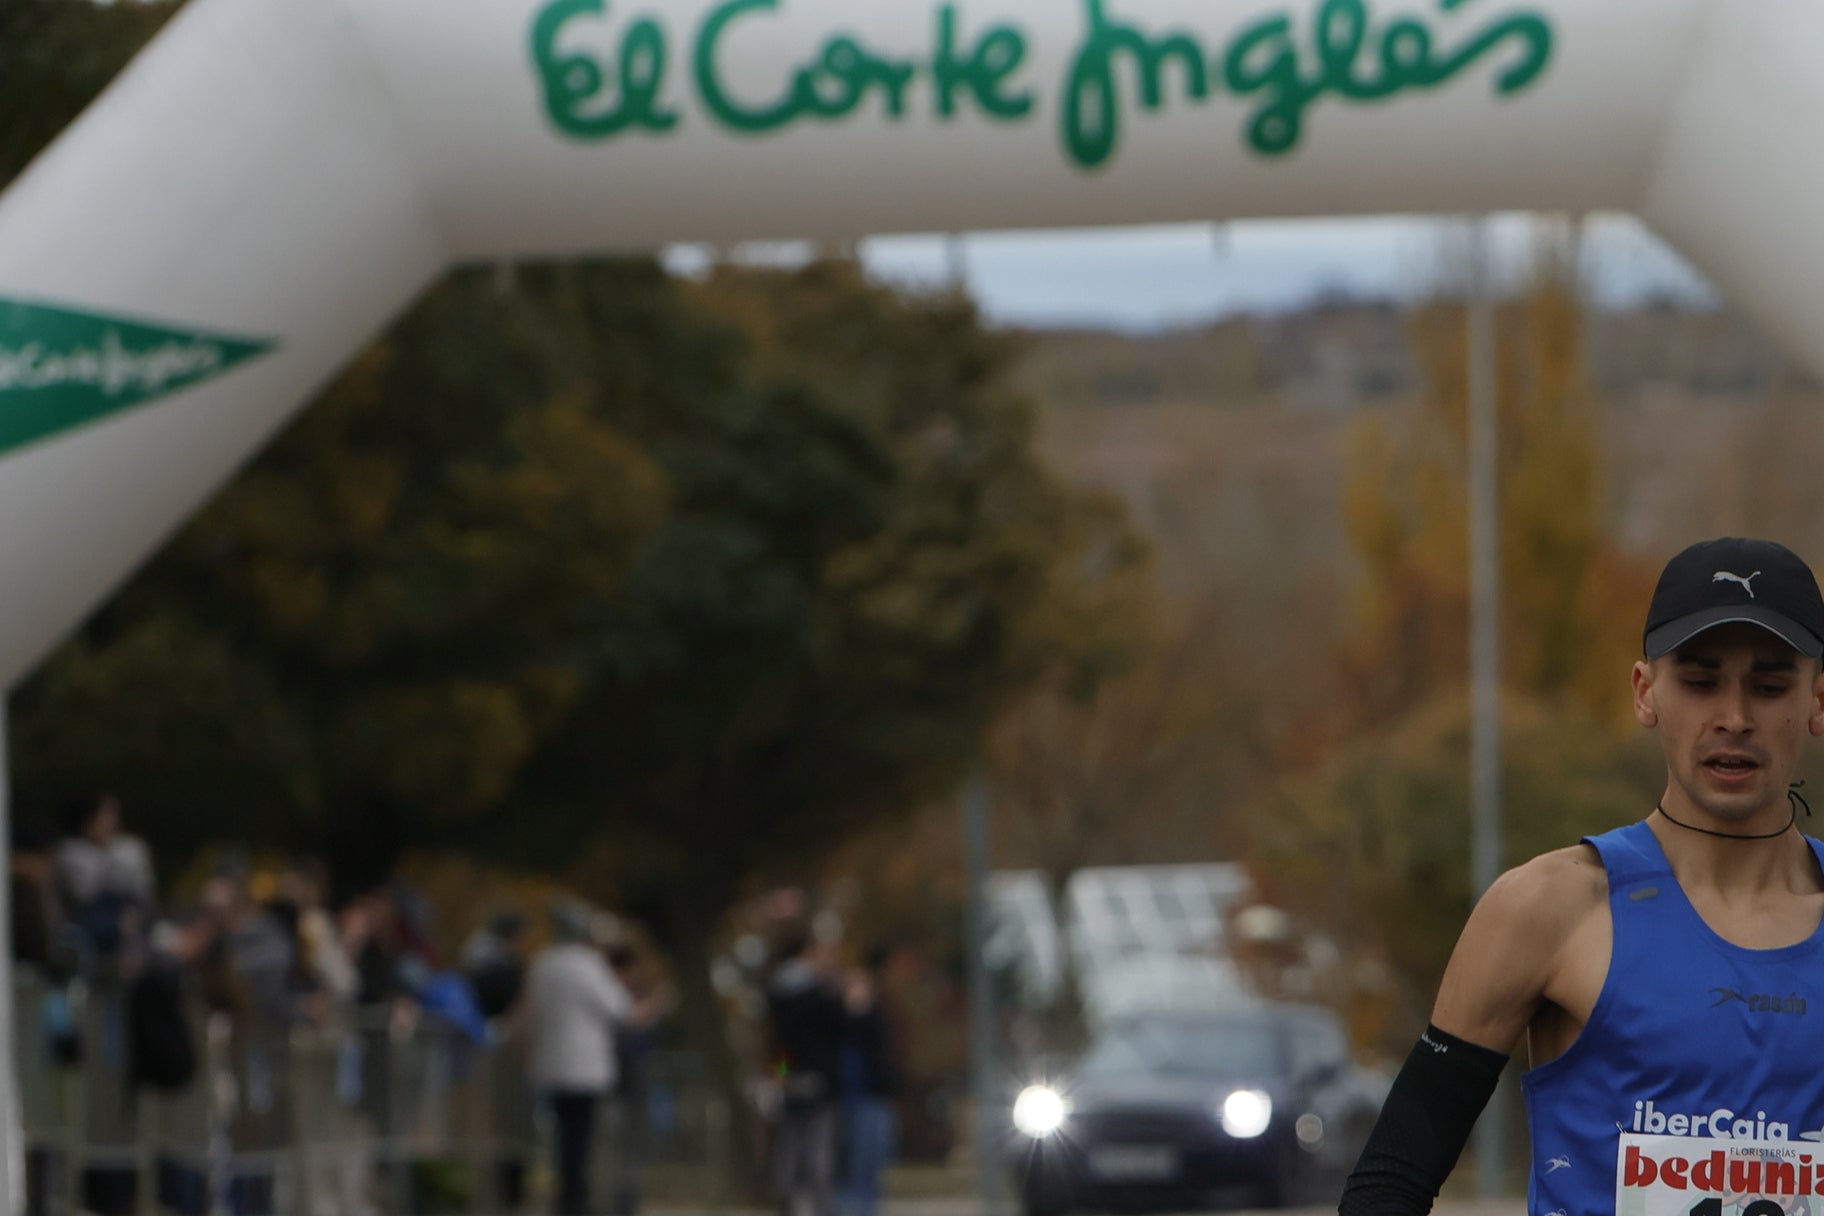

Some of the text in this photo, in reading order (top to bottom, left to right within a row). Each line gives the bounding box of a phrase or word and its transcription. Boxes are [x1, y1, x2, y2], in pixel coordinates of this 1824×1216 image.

[529, 0, 680, 138] El
[695, 0, 1033, 133] Corte
[1730, 1147, 1796, 1158] FLORISTERÍAS
